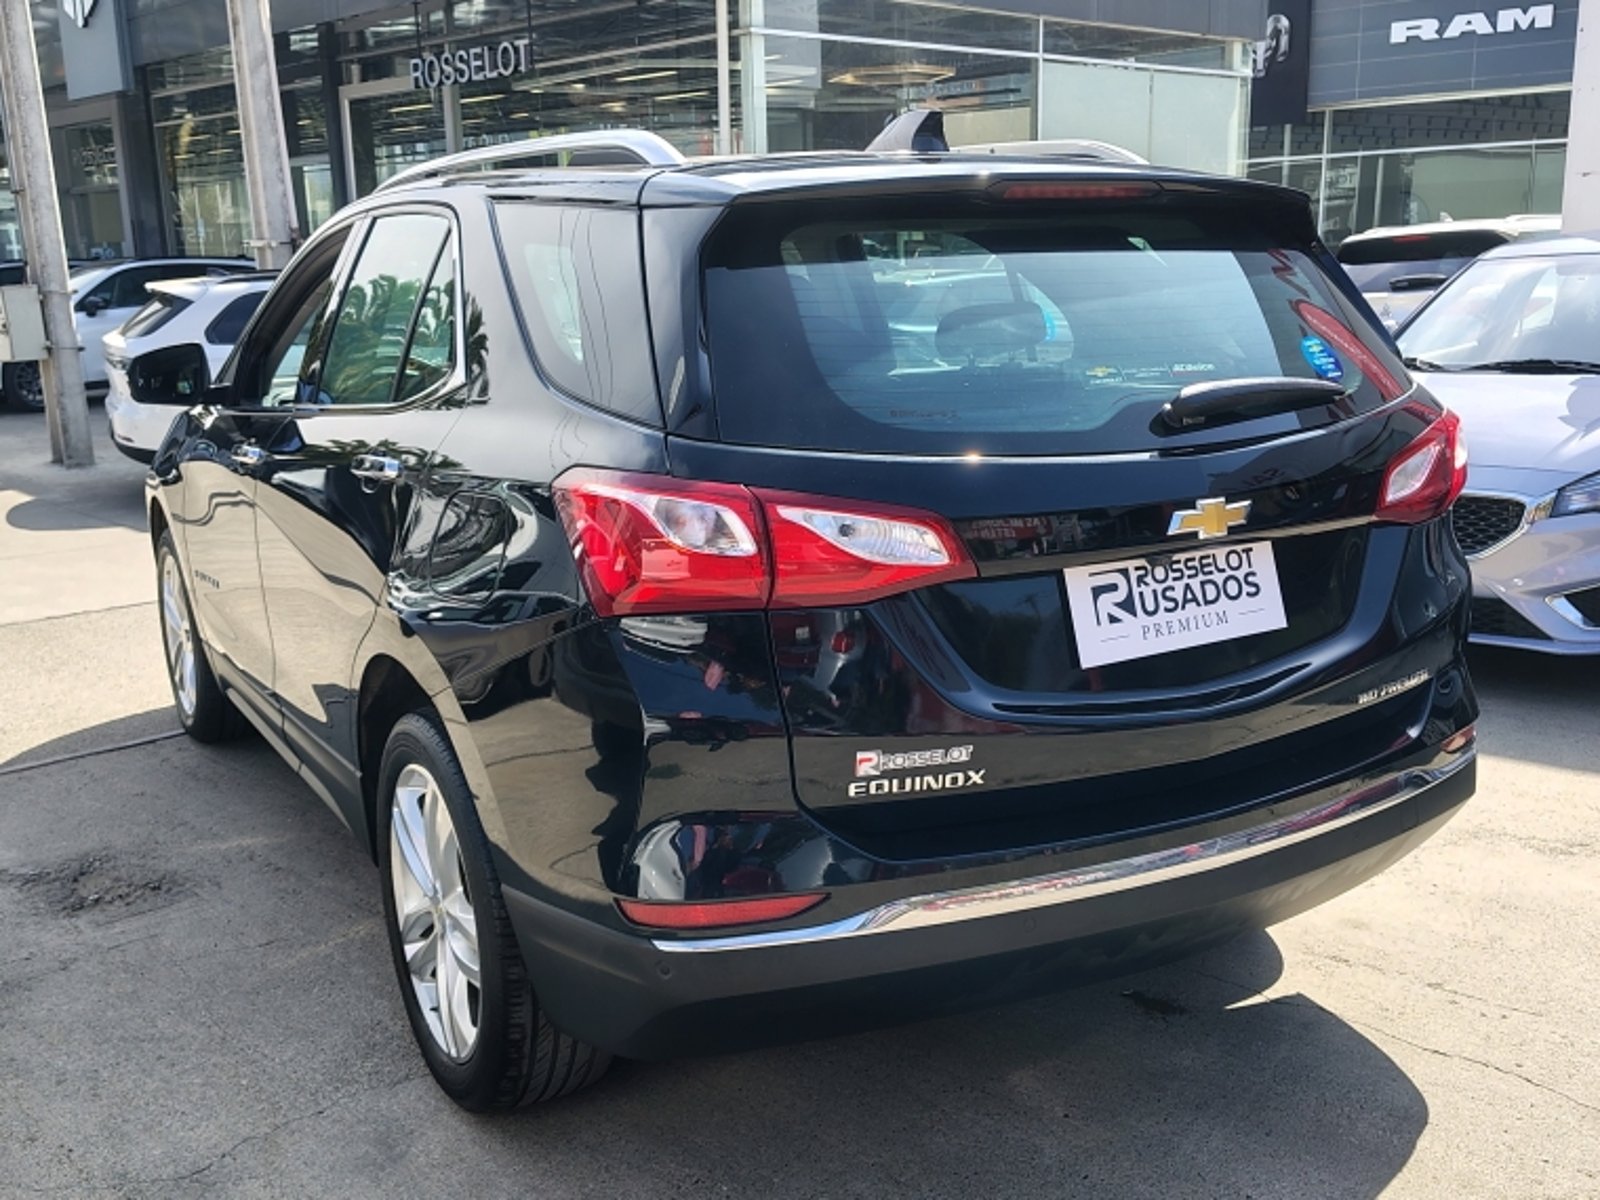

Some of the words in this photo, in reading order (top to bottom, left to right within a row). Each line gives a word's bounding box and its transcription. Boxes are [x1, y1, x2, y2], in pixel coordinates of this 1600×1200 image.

[1389, 3, 1554, 44] RAM
[409, 39, 530, 89] ROSSELOT
[1134, 547, 1254, 588] ROSSELOT
[1139, 571, 1262, 618] USADOS
[1141, 610, 1230, 640] PREMIUM
[881, 744, 974, 770] ROSSELOT
[847, 768, 986, 797] EQUINOX
